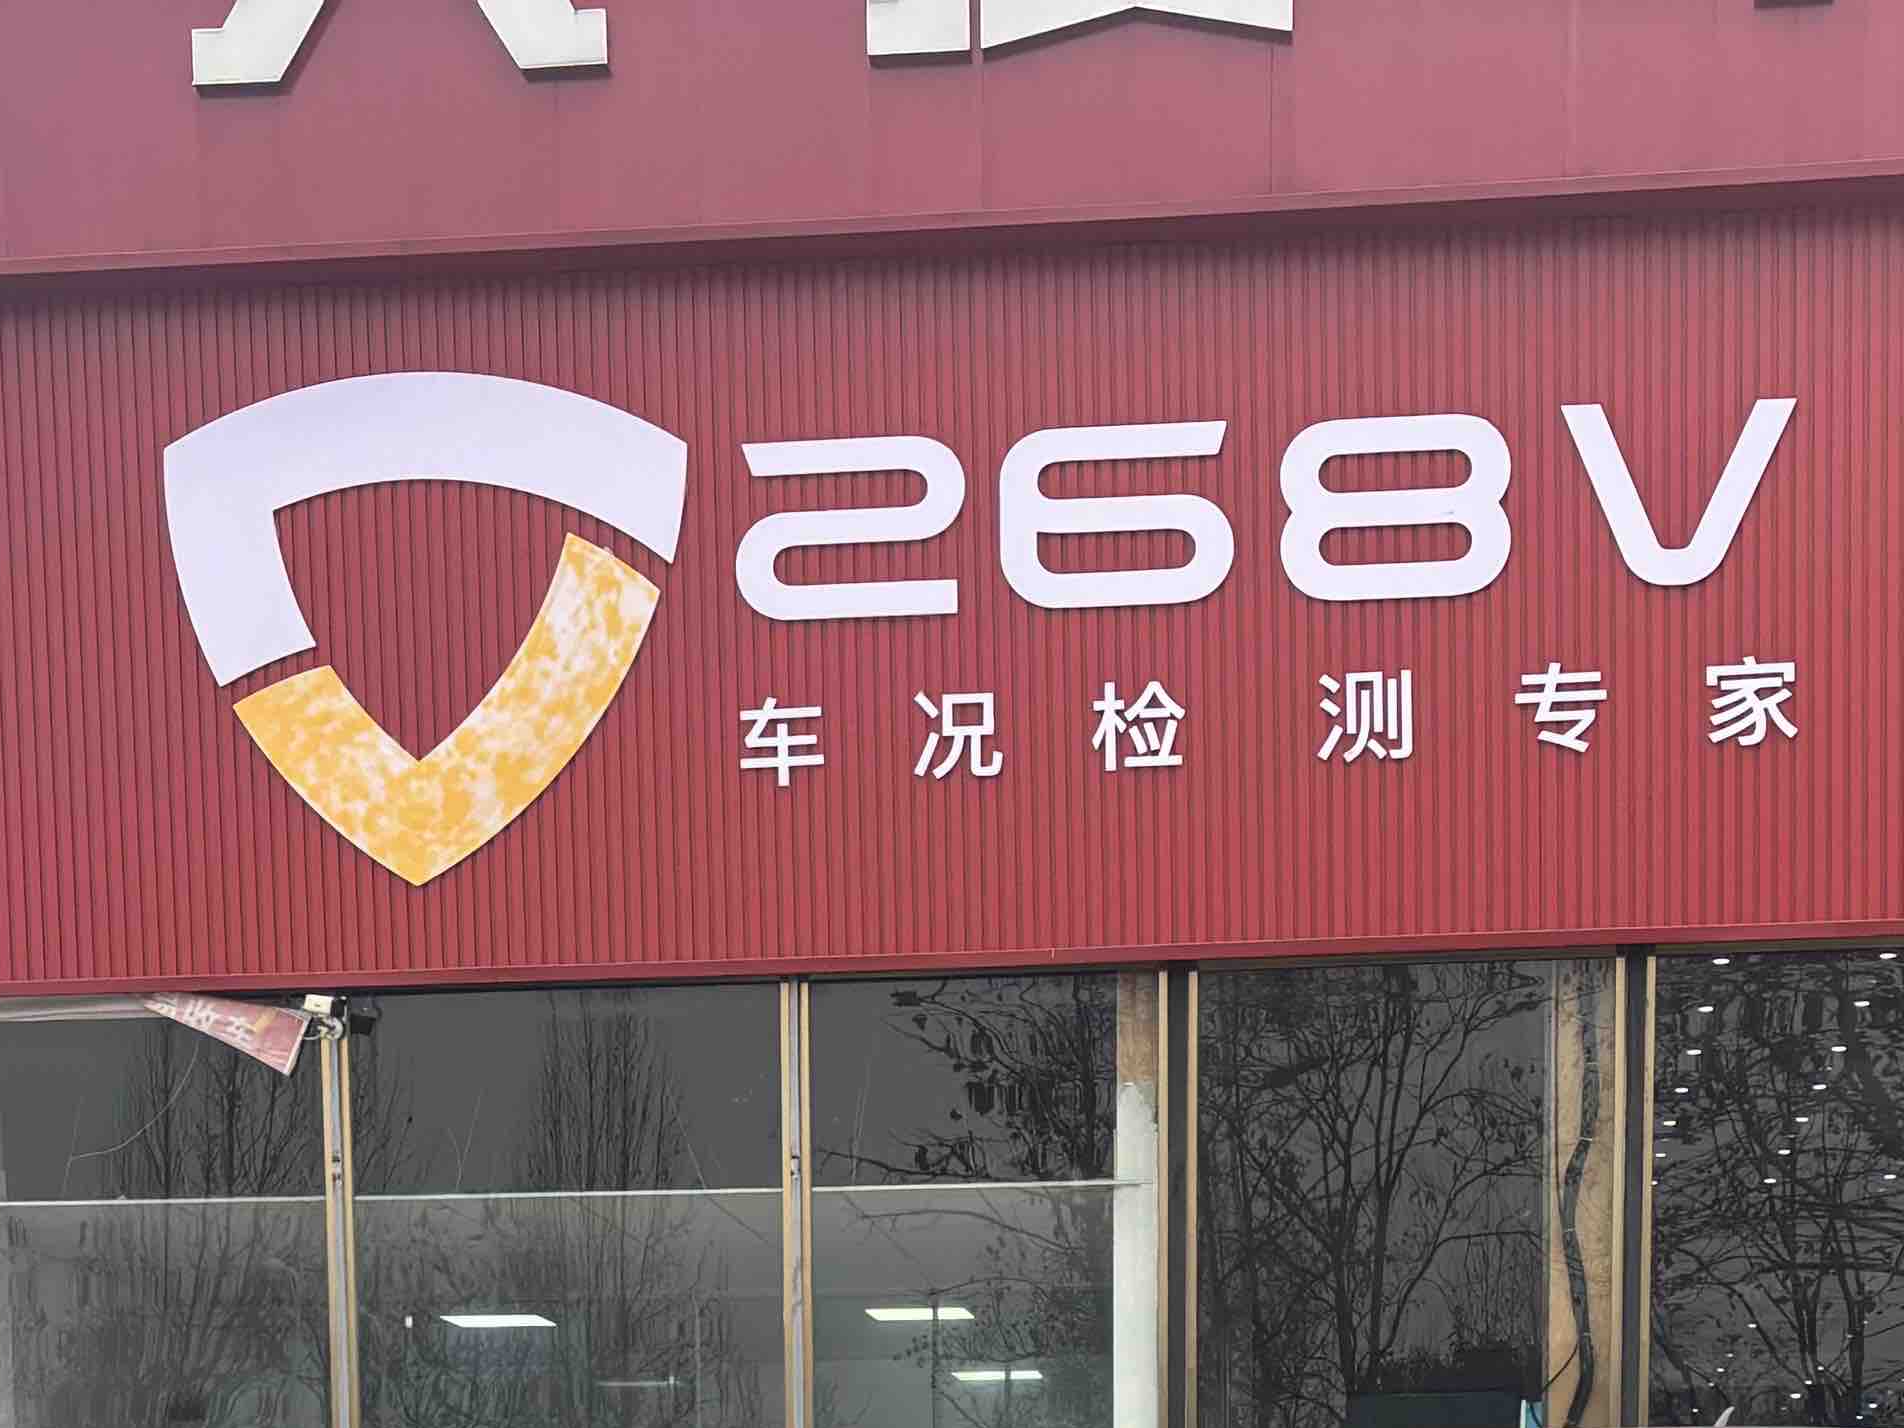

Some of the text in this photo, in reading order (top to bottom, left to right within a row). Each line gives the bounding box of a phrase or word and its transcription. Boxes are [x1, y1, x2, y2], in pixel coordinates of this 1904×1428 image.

[734, 396, 1797, 622] 268V
[736, 655, 1800, 787] 车况检测专家
